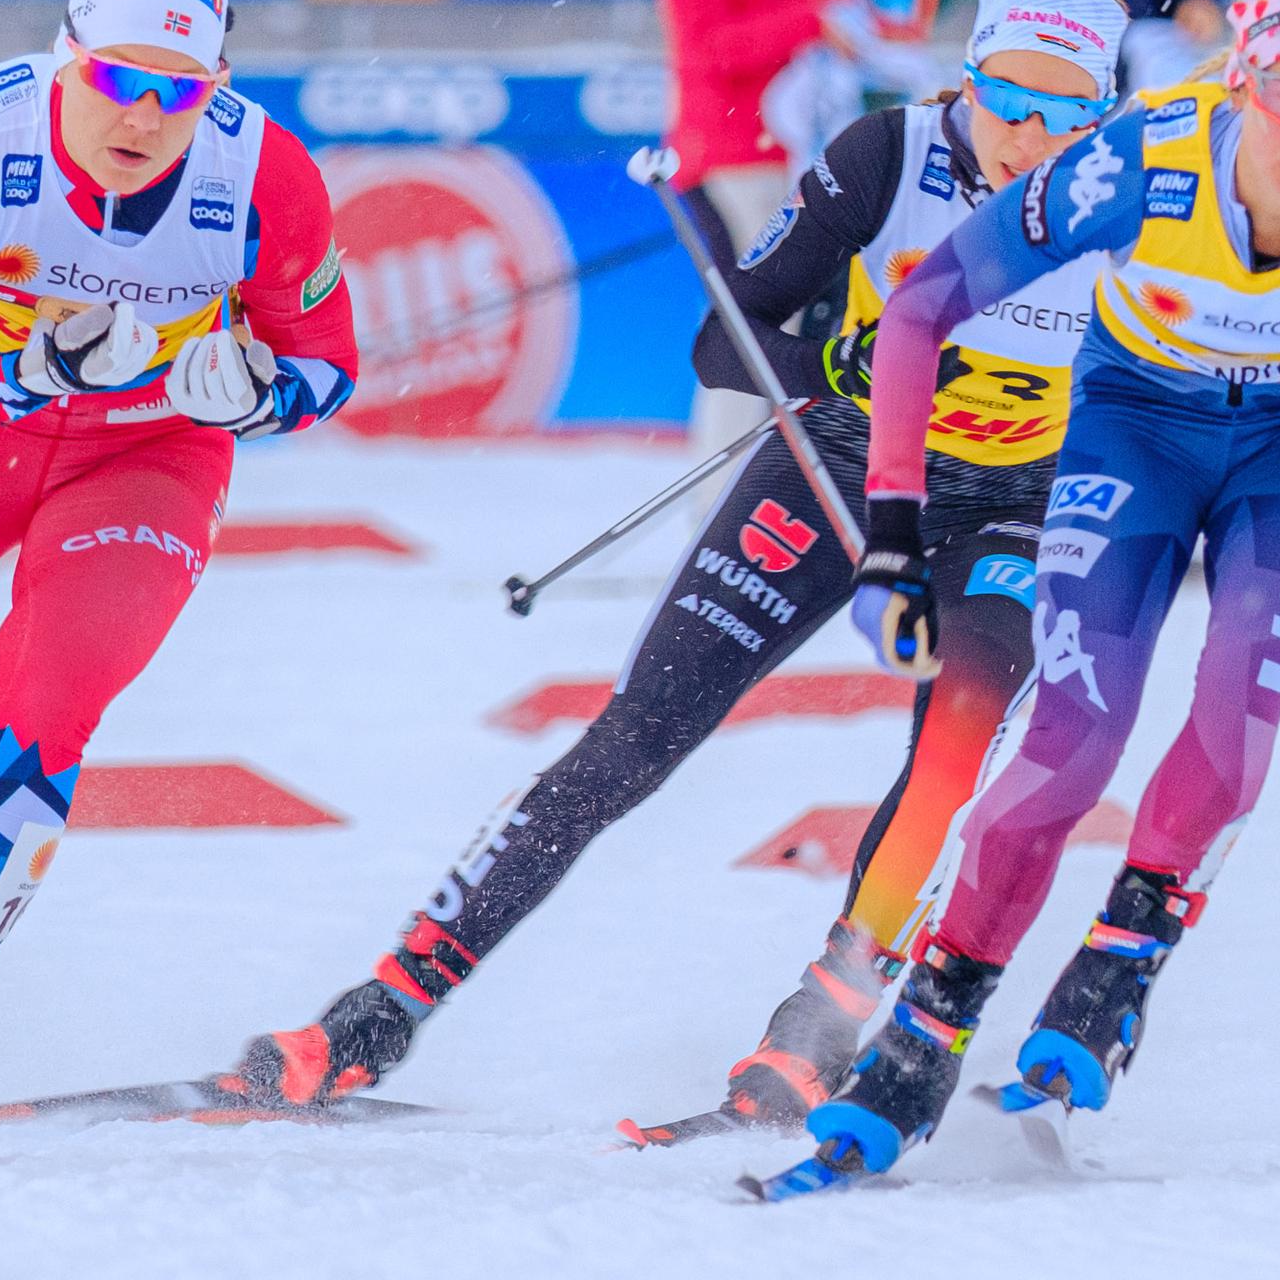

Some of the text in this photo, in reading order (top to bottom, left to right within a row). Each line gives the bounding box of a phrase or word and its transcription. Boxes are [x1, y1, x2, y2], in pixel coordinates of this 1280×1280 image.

[1149, 173, 1194, 191] MINI
[192, 206, 233, 224] coop
[1148, 201, 1187, 216] coop
[61, 524, 196, 571] CRAFT
[694, 546, 799, 625] WÜRTH
[697, 598, 767, 653] TERREX
